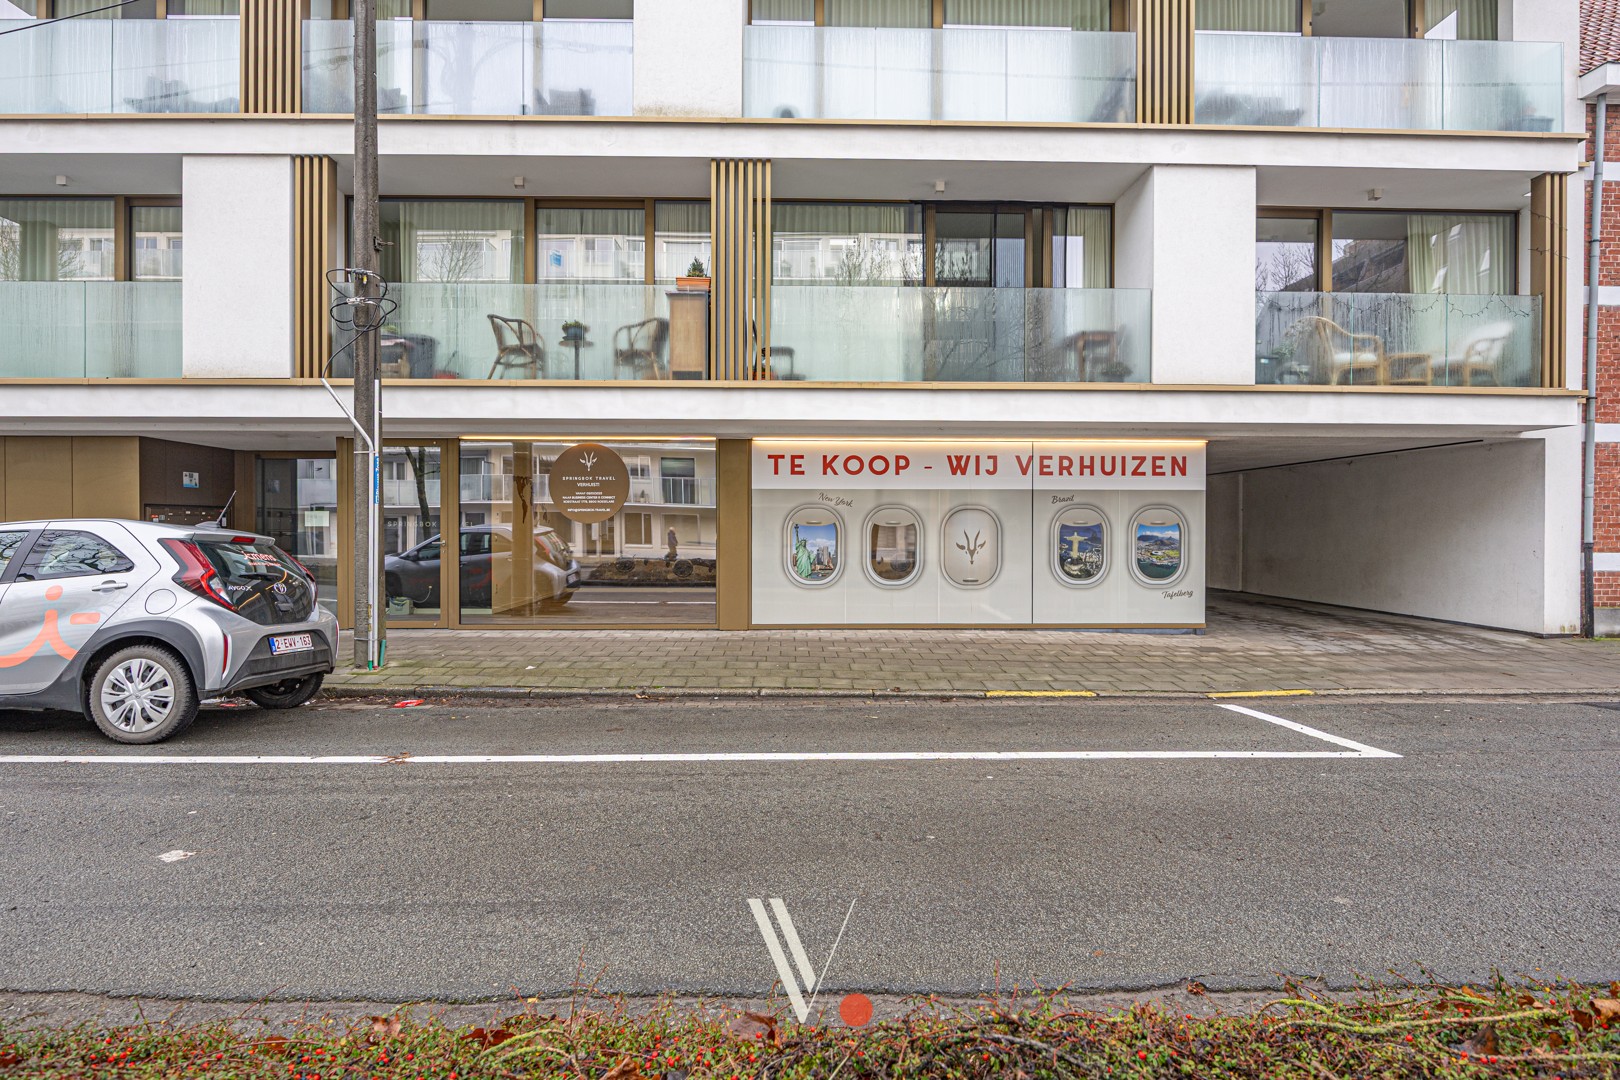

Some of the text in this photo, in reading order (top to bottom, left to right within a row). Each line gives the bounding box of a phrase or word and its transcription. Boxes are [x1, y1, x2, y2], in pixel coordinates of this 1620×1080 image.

[768, 454, 805, 476] TE
[822, 454, 910, 476] KOOP
[947, 455, 998, 476] WIJ
[1016, 455, 1187, 477] VERHUIZEN
[818, 491, 854, 507] New York
[1161, 589, 1194, 600] Tafelberg
